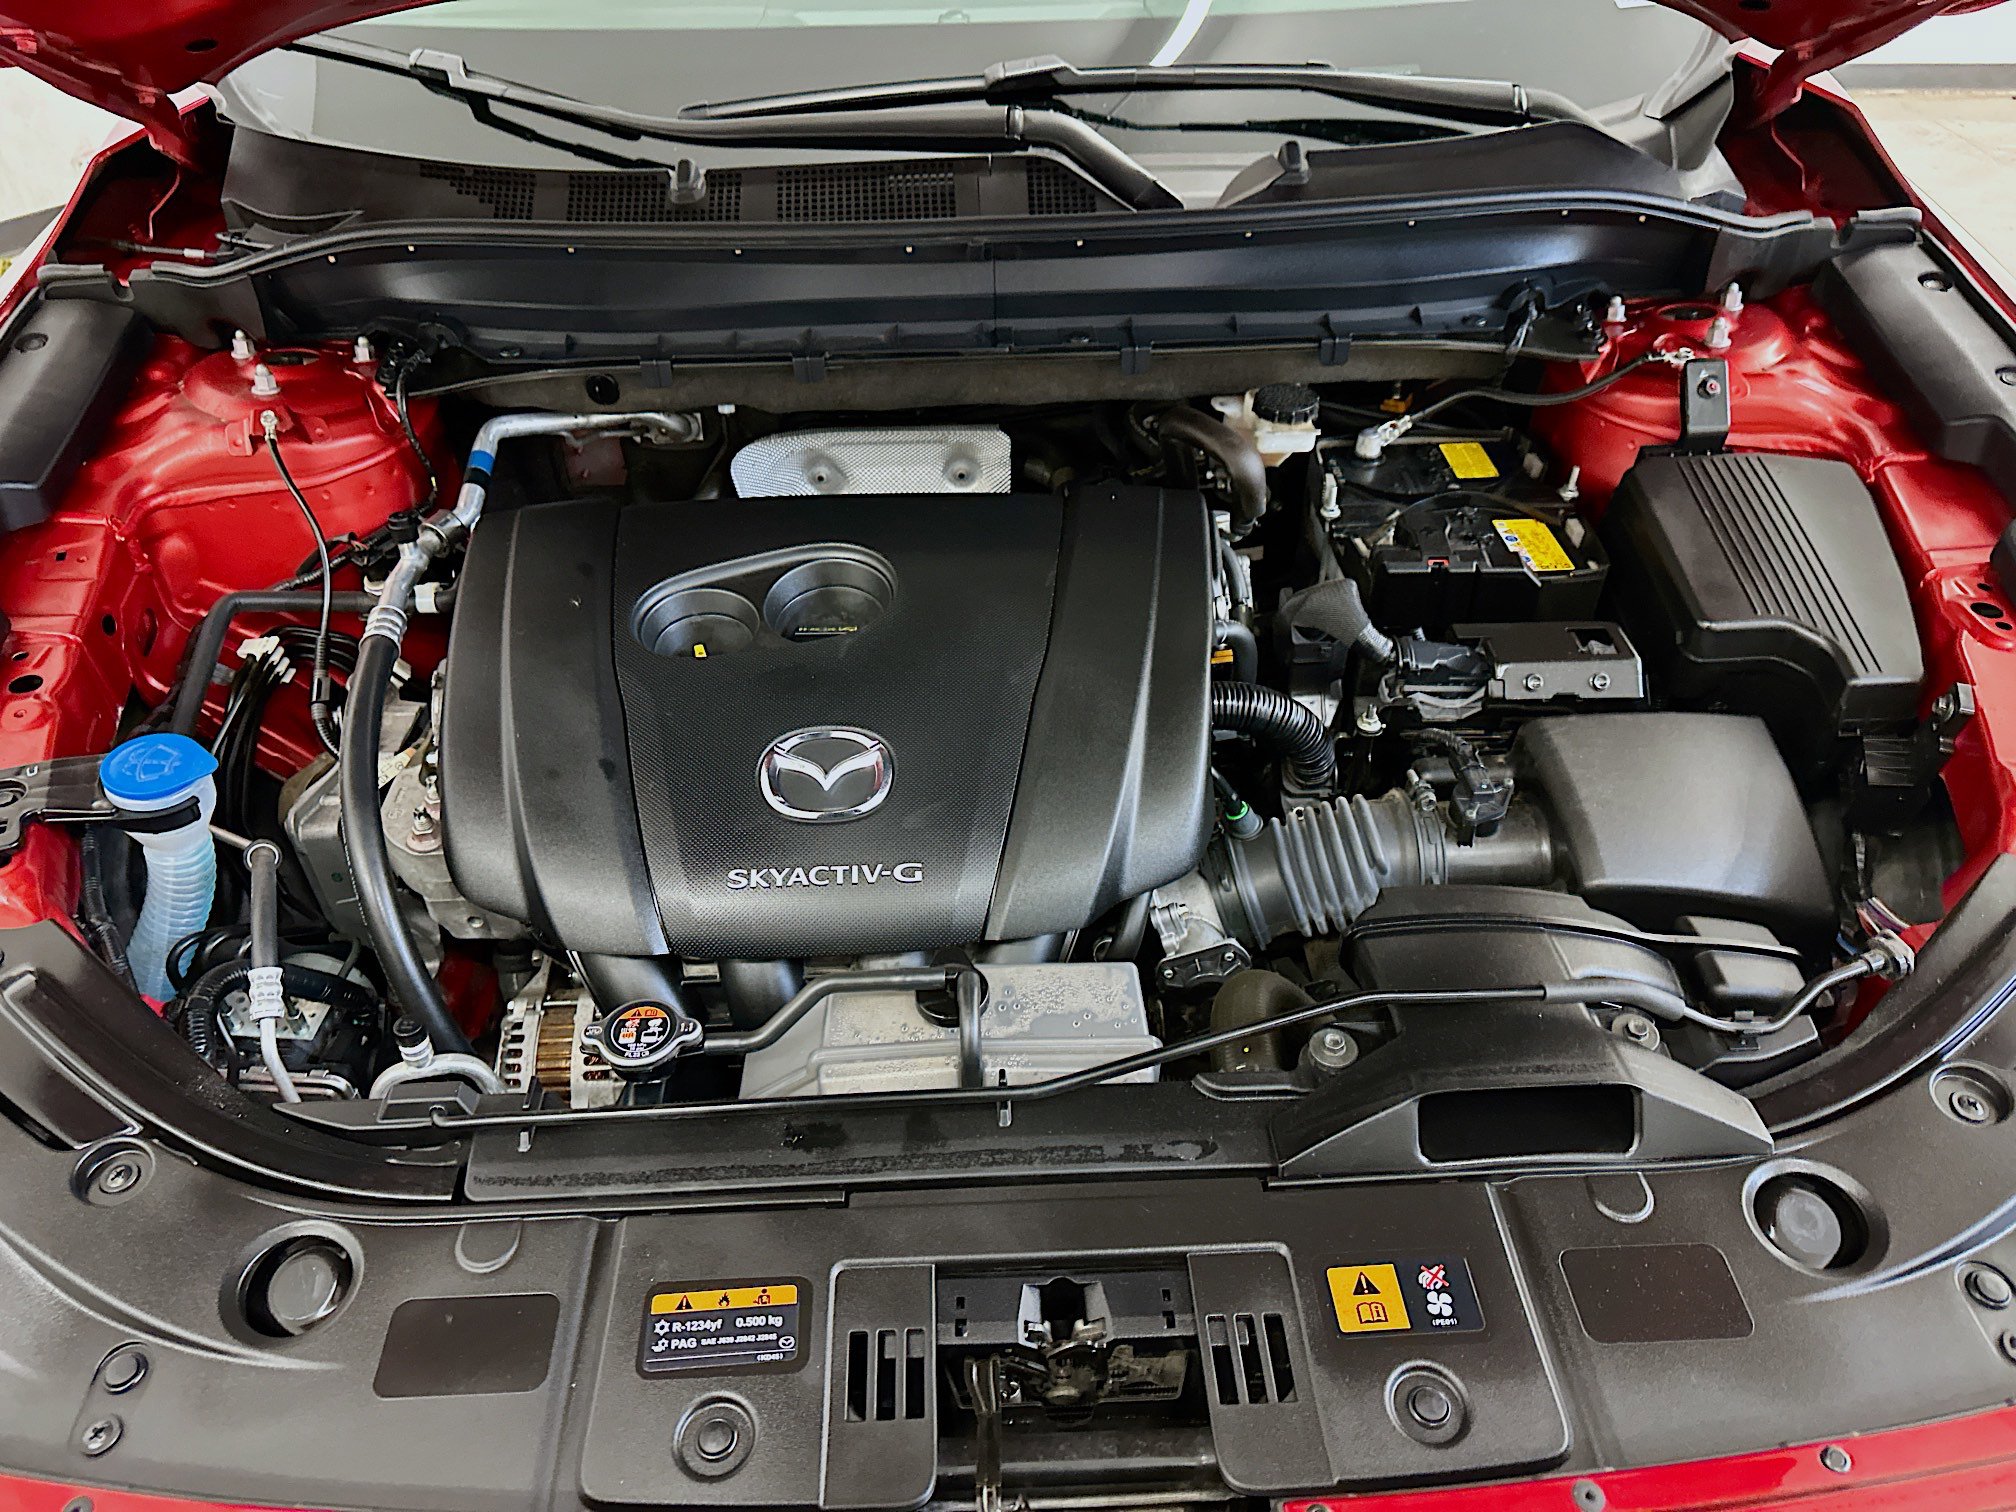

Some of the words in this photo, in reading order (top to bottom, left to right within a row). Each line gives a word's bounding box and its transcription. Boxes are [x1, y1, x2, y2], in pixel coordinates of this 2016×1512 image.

[726, 862, 923, 889] SKYACTIV-G
[672, 1319, 722, 1332] R-1234yf
[735, 1316, 765, 1328] 0.500
[768, 1315, 783, 1327] kg
[670, 1337, 697, 1350] PAG
